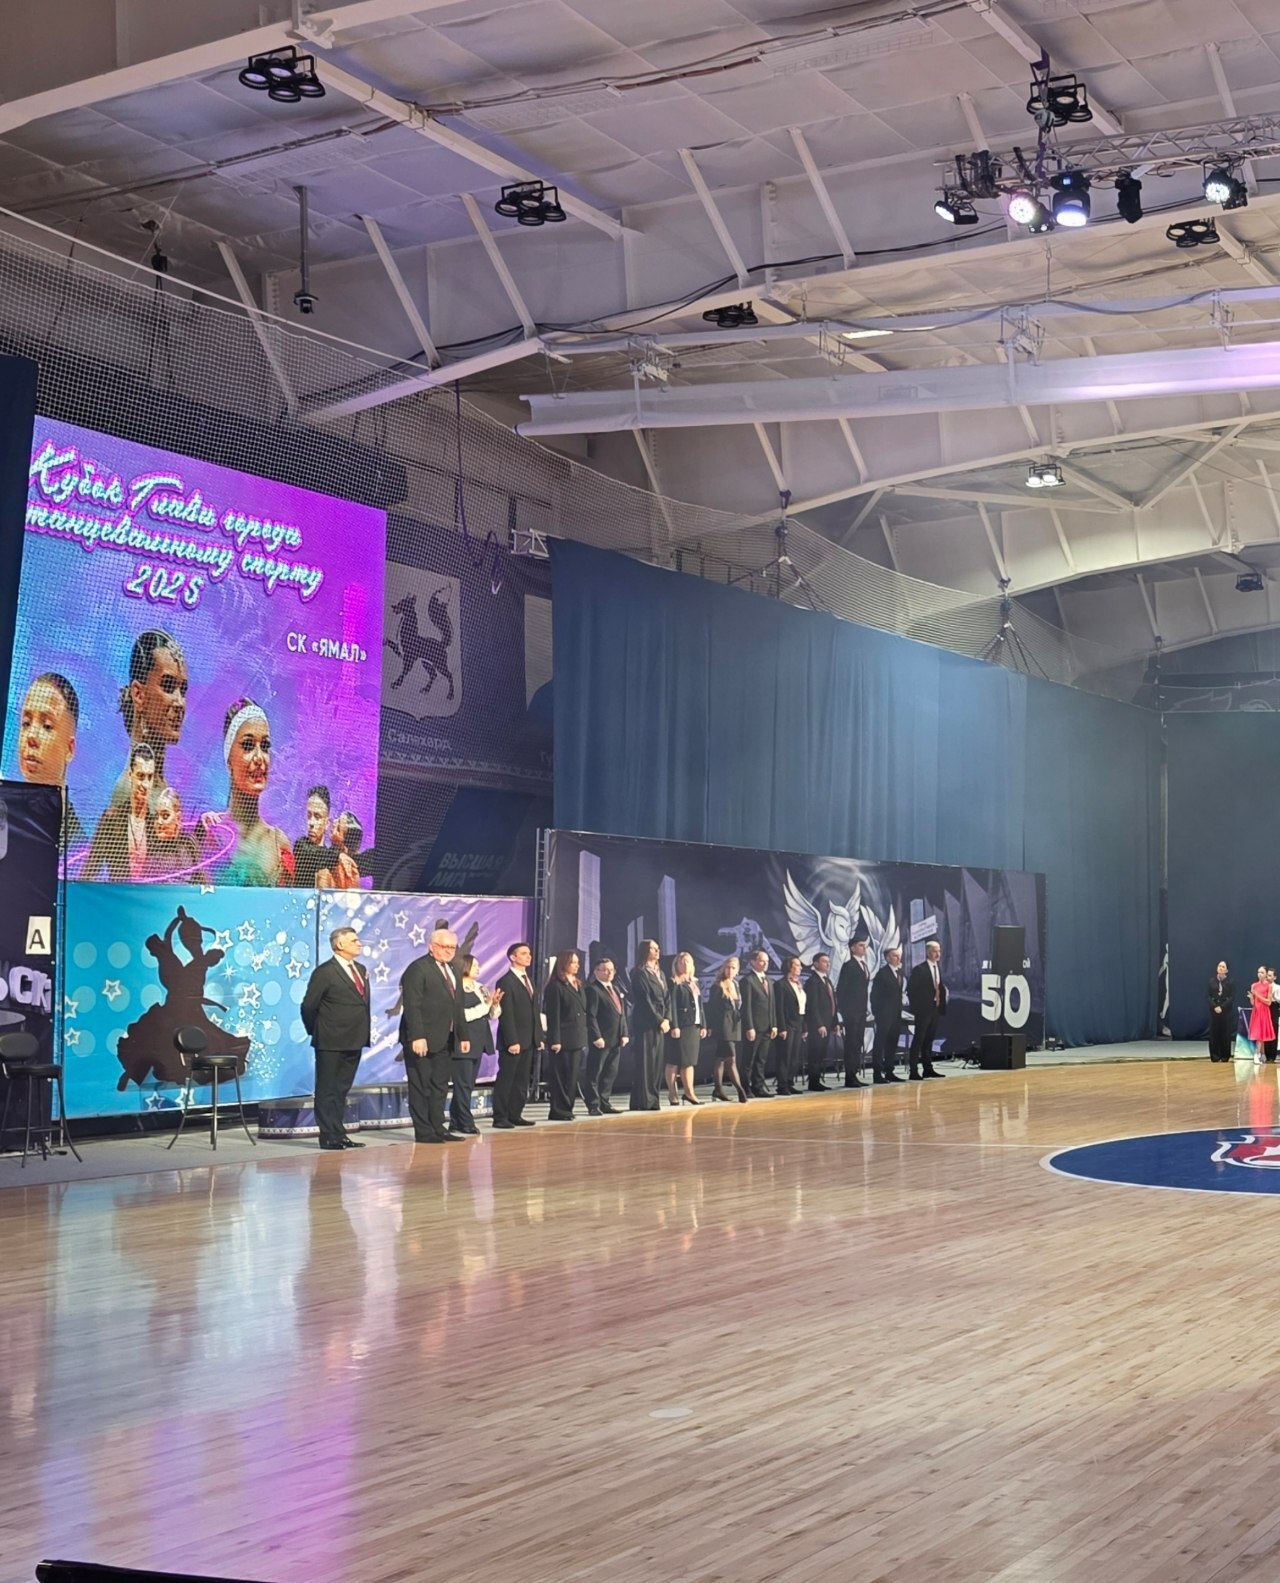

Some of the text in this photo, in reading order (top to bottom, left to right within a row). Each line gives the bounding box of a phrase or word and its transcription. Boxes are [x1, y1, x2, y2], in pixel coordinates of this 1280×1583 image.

[29, 441, 303, 552] Кубок Главы города
[126, 564, 206, 606] 2025
[239, 551, 324, 598] спорту
[286, 631, 367, 663] СК «ЯМАЛ»
[981, 973, 1031, 1029] 50
